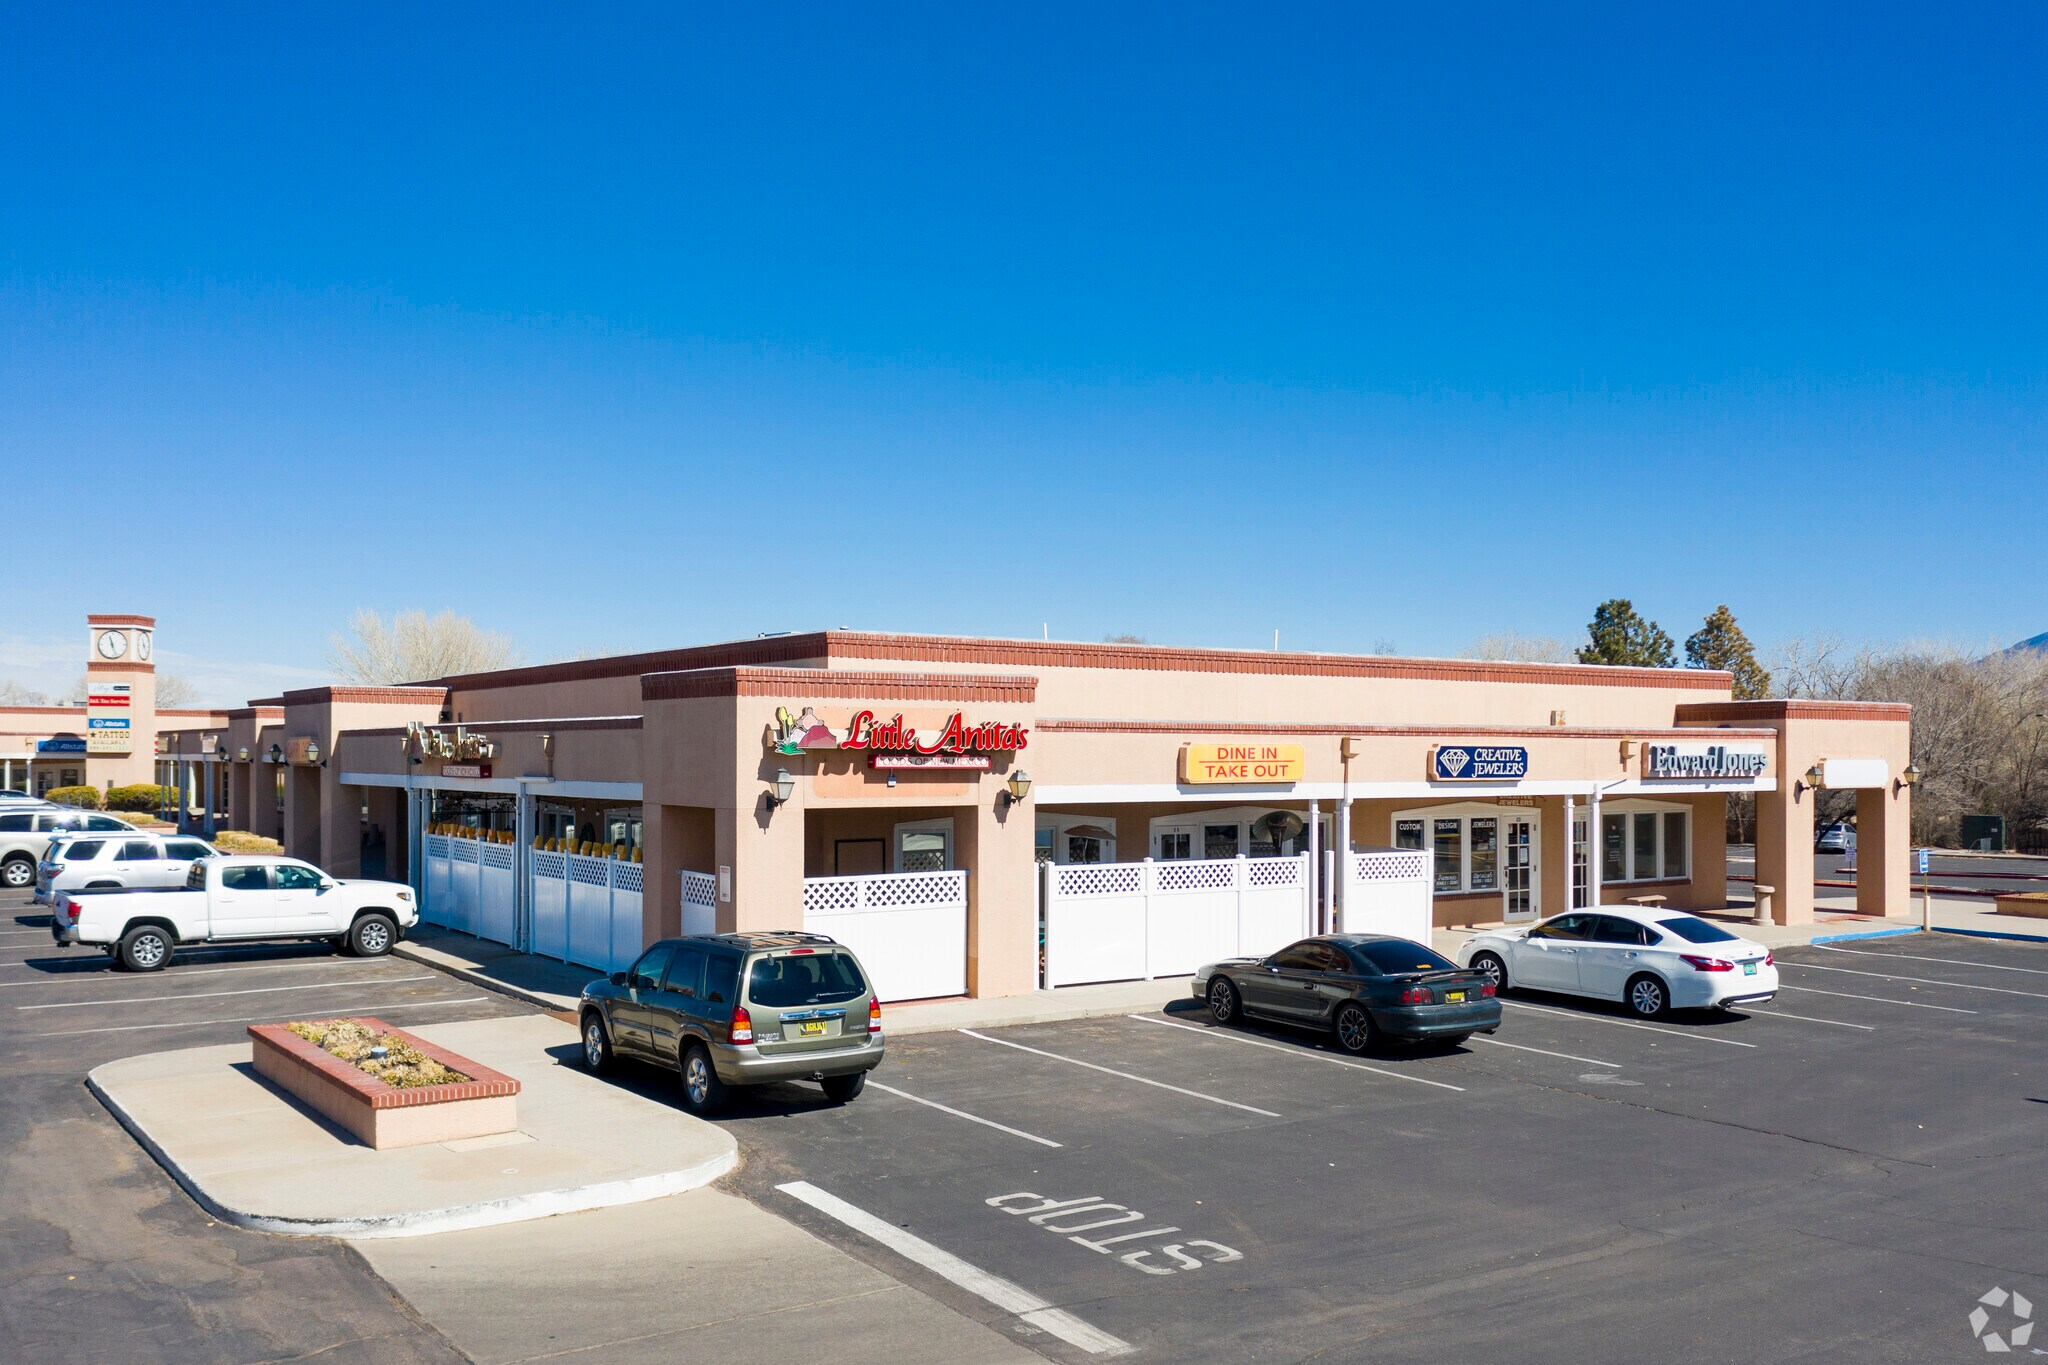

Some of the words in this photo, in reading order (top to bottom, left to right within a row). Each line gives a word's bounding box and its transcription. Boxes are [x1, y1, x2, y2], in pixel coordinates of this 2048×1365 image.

[98, 731, 130, 739] TATTOO
[841, 710, 916, 750] Little
[916, 712, 1030, 754] Anita's
[1217, 747, 1256, 760] DINE
[1261, 747, 1277, 760] IN
[1474, 748, 1522, 761] CREATIVE
[1654, 746, 1718, 772] Edward
[1719, 745, 1768, 775] Jones
[879, 755, 912, 766] FOODS
[914, 756, 929, 766] OF
[930, 755, 952, 766] NEW
[953, 755, 989, 766] MEXICO
[1205, 765, 1248, 778] TAKE
[1254, 765, 1289, 777] OUT
[1471, 762, 1524, 778] JEWELERS
[1399, 823, 1423, 831] CUSTOM
[985, 1192, 1244, 1275] STOP
